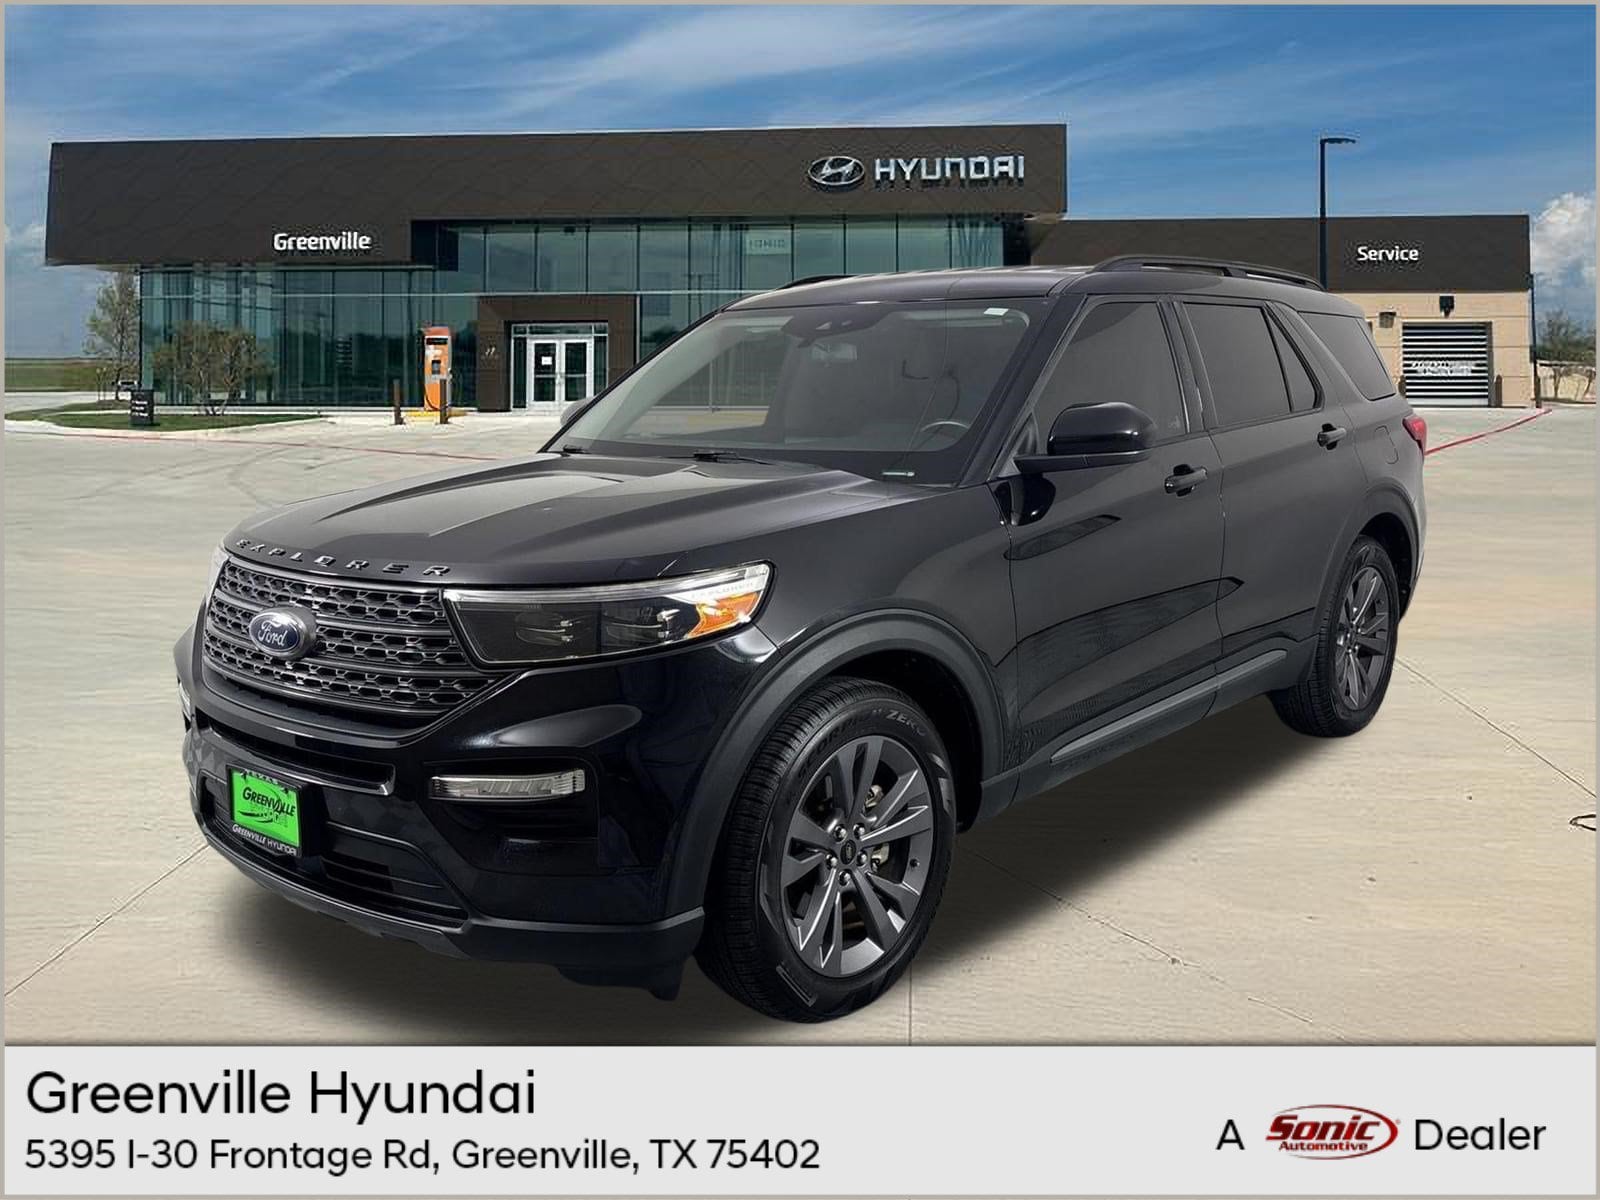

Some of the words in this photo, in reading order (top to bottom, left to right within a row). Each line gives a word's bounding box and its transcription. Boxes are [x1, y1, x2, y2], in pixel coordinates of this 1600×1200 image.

[874, 155, 1025, 181] HYUNDAI
[273, 231, 372, 251] Greenville
[1356, 245, 1420, 261] Service
[236, 538, 451, 577] EXPLORER
[257, 618, 288, 647] Ford
[242, 786, 296, 817] GREENVILLE
[231, 823, 266, 845] GREENVILLE
